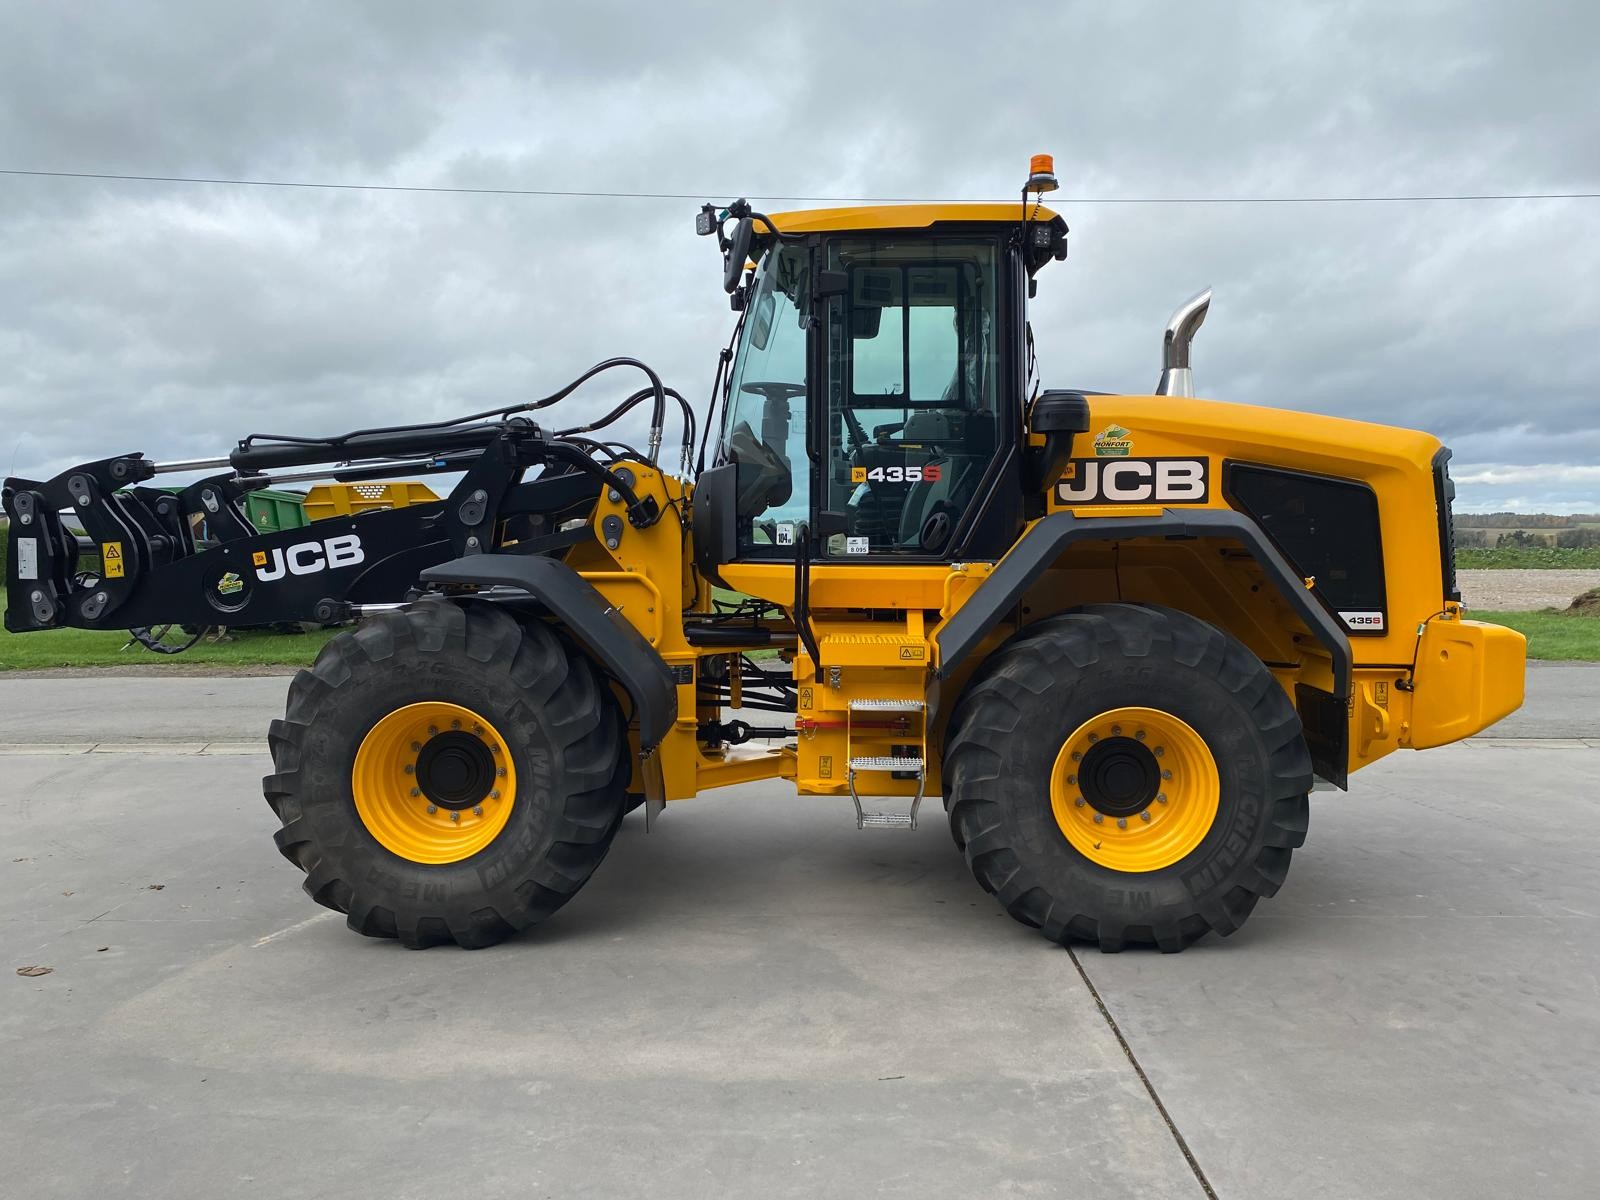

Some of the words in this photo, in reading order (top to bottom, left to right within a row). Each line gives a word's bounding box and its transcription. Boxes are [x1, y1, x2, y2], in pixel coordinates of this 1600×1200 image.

[867, 466, 942, 482] 435S
[1058, 460, 1205, 501] JCB
[256, 534, 364, 582] JCB
[1348, 616, 1381, 625] 435S
[485, 747, 551, 889] MICEIN
[1189, 753, 1260, 896] MICHELIN
